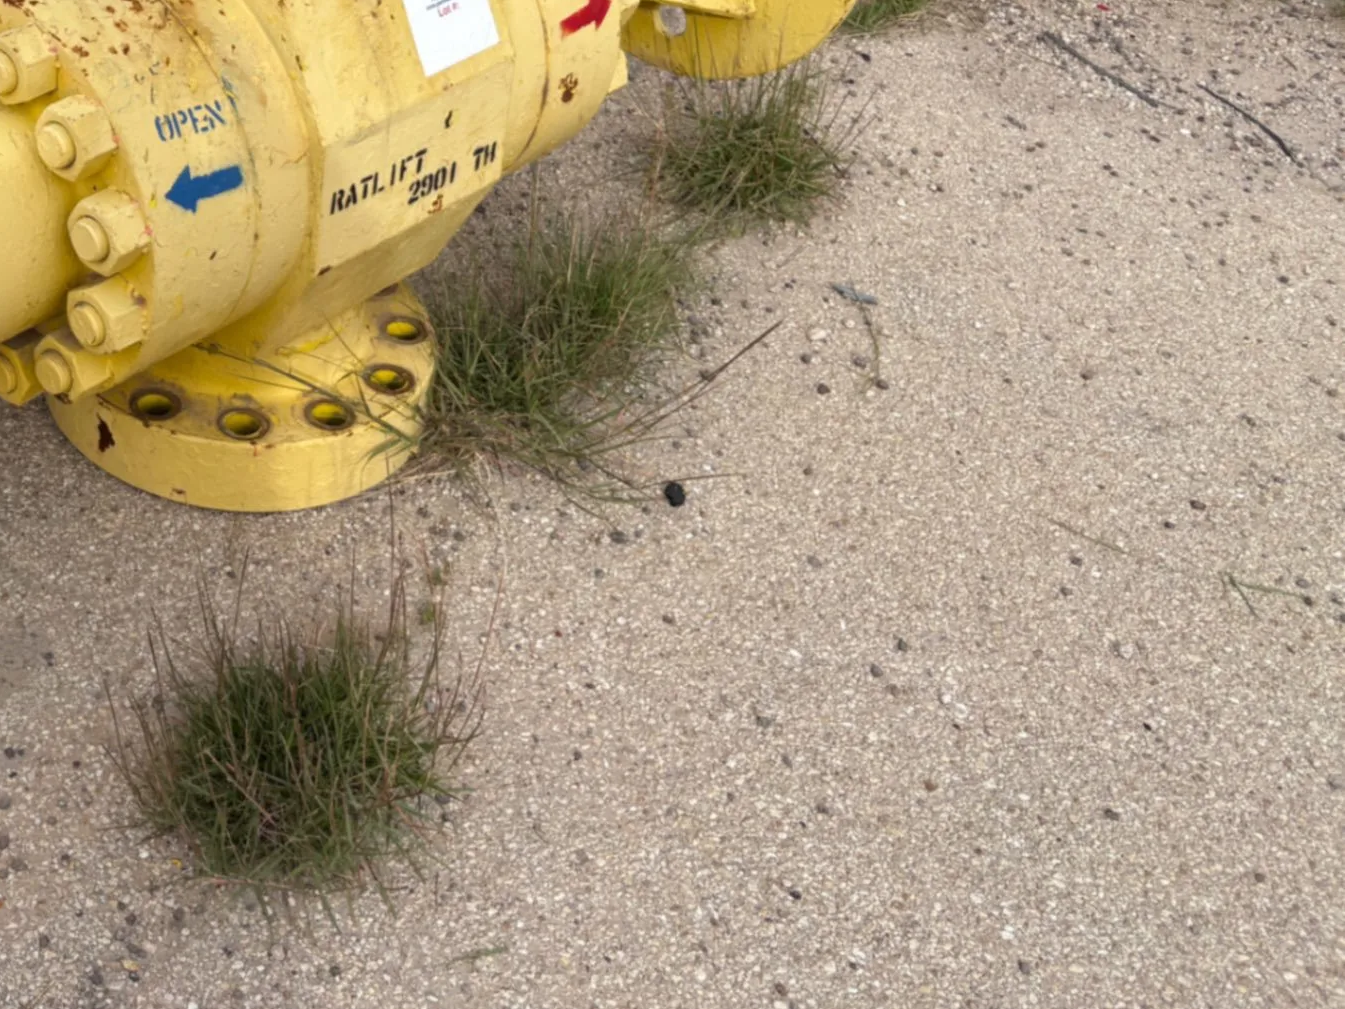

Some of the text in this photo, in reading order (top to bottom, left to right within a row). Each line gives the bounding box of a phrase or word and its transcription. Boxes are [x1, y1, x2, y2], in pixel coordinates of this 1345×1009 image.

[155, 100, 226, 142] OPEN
[329, 147, 428, 215] RATLIFT
[407, 141, 497, 205] 2901 TH
